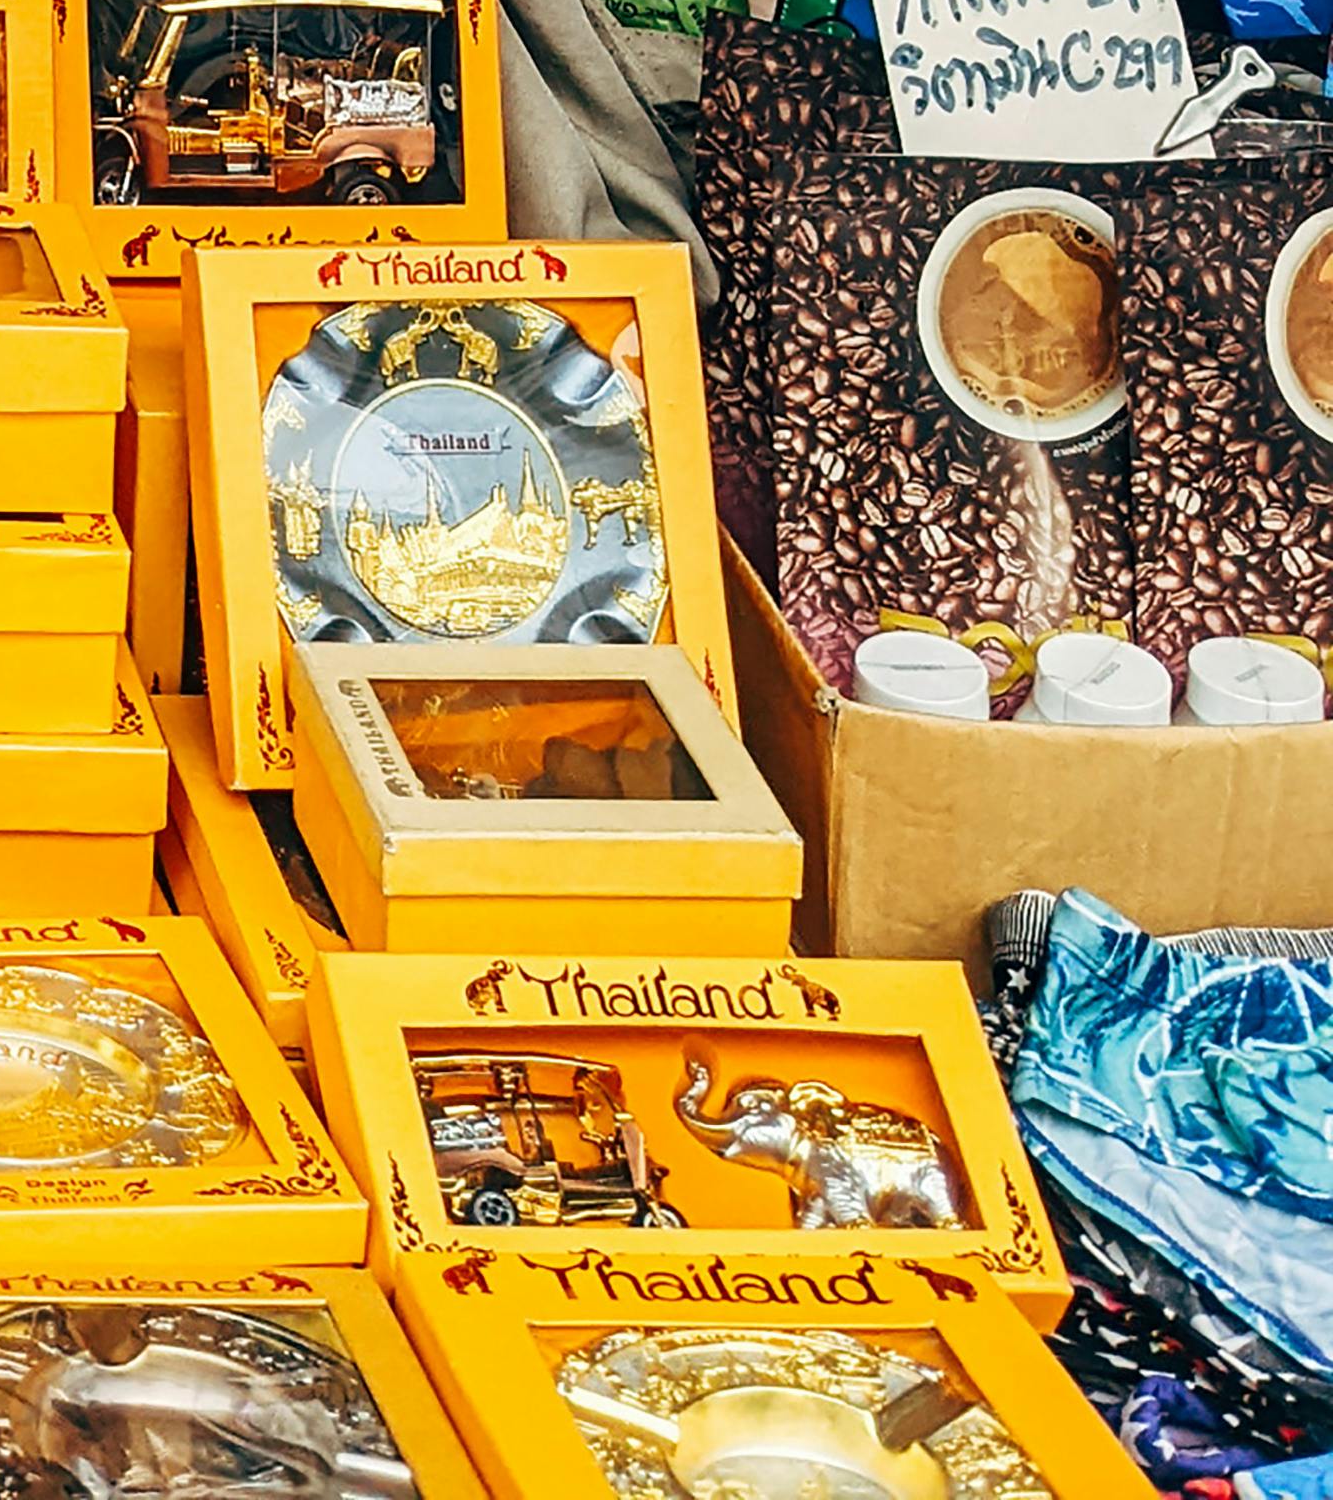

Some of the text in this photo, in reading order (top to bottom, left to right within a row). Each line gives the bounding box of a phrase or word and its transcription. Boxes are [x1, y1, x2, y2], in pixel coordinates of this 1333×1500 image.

[357, 251, 528, 286] Thailand
[517, 963, 783, 1021] Thailand
[520, 1252, 891, 1306] Thailand
